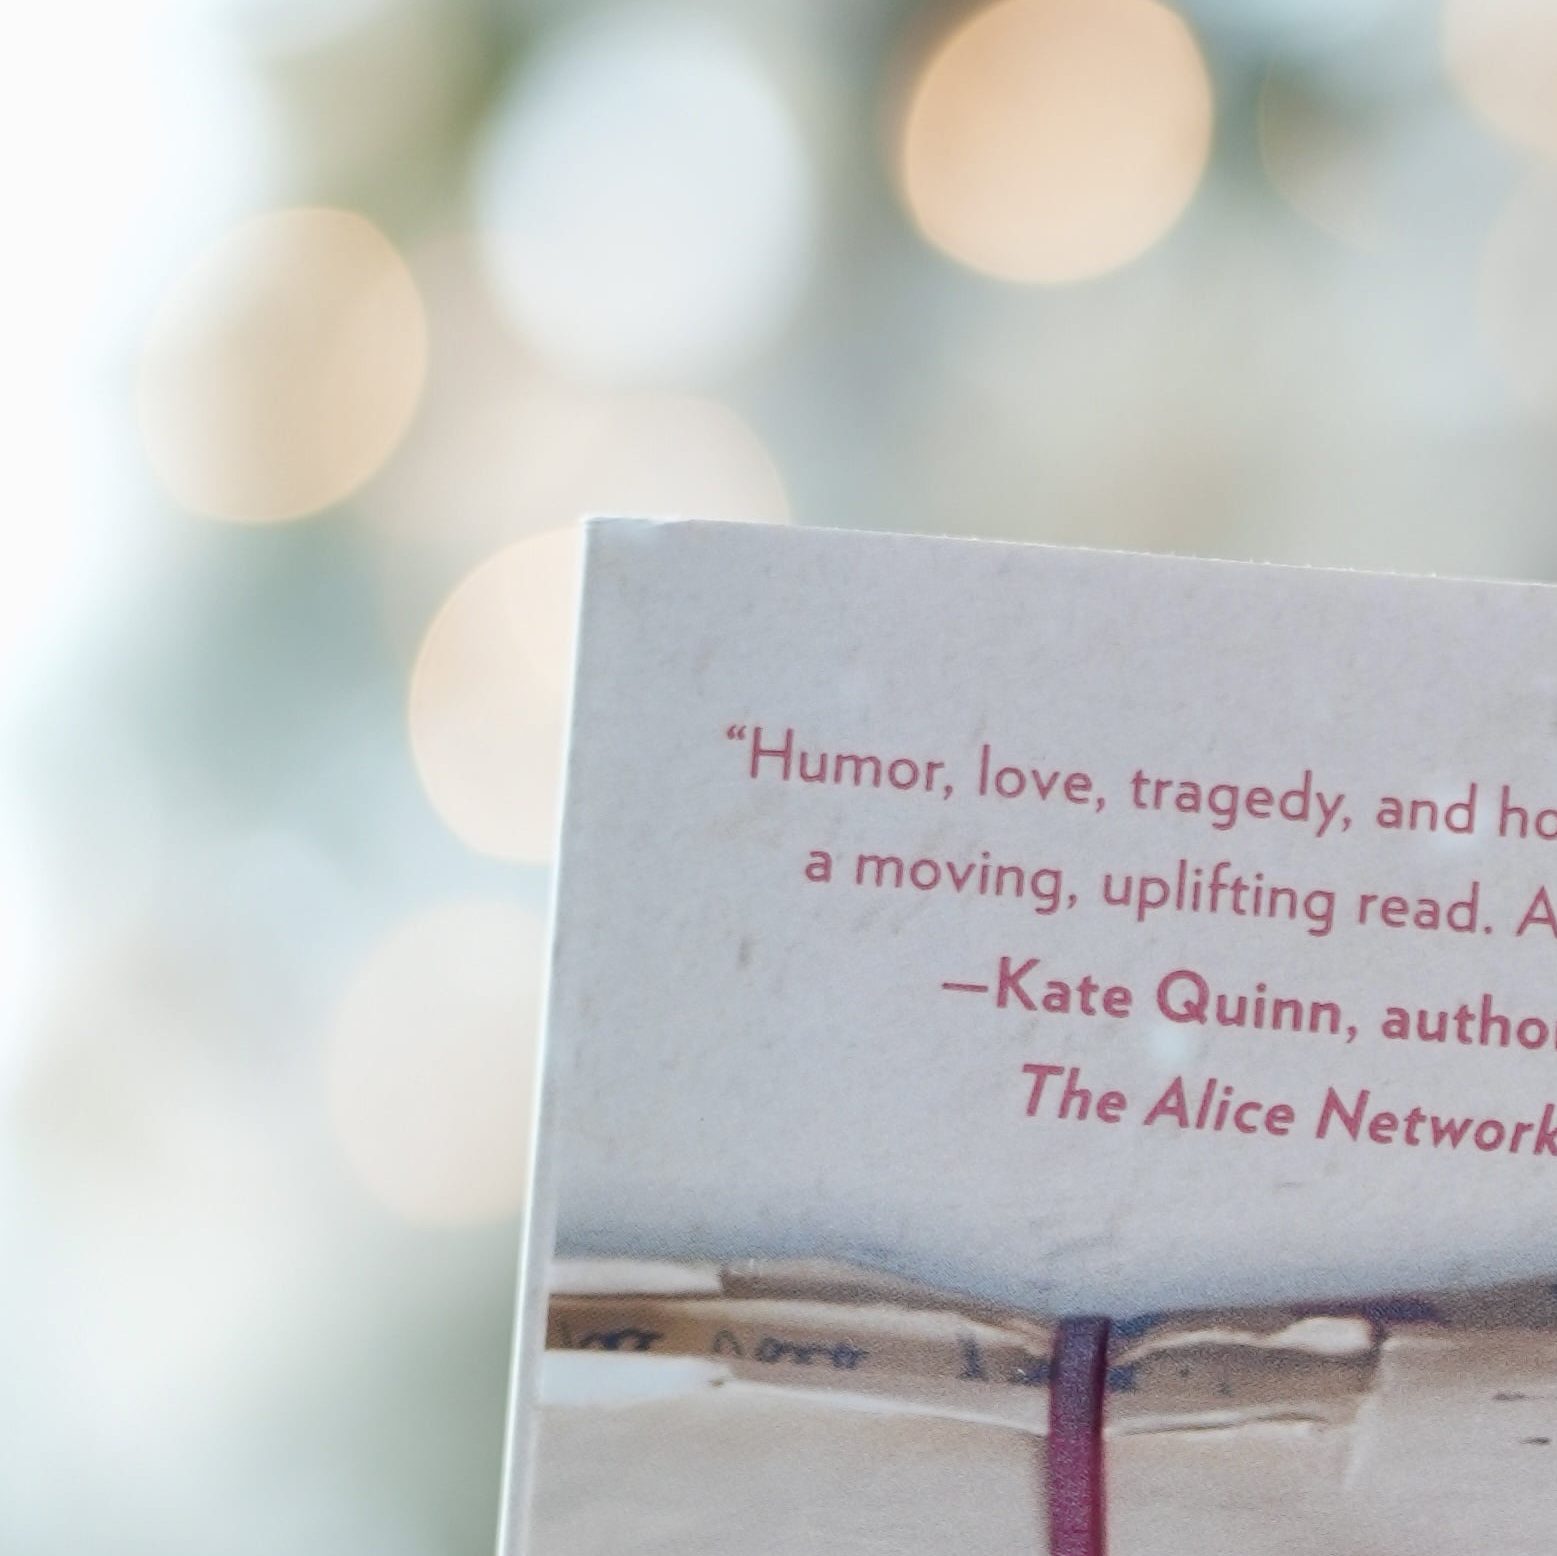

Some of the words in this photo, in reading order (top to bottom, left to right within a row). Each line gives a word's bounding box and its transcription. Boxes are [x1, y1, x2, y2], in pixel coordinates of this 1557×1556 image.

[725, 724, 955, 799] “Humor,
[977, 743, 1107, 813] love,
[1130, 769, 1353, 837] tragedy,
[1374, 780, 1479, 834] and
[803, 848, 833, 883] a
[854, 853, 1079, 916] moving,
[1102, 858, 1336, 938] uplifting
[1357, 880, 1493, 936] read.
[942, 954, 1133, 1019] —Kate
[1154, 967, 1358, 1042] Quinn,
[1021, 1061, 1128, 1125] The
[1142, 1075, 1296, 1137] Alice
